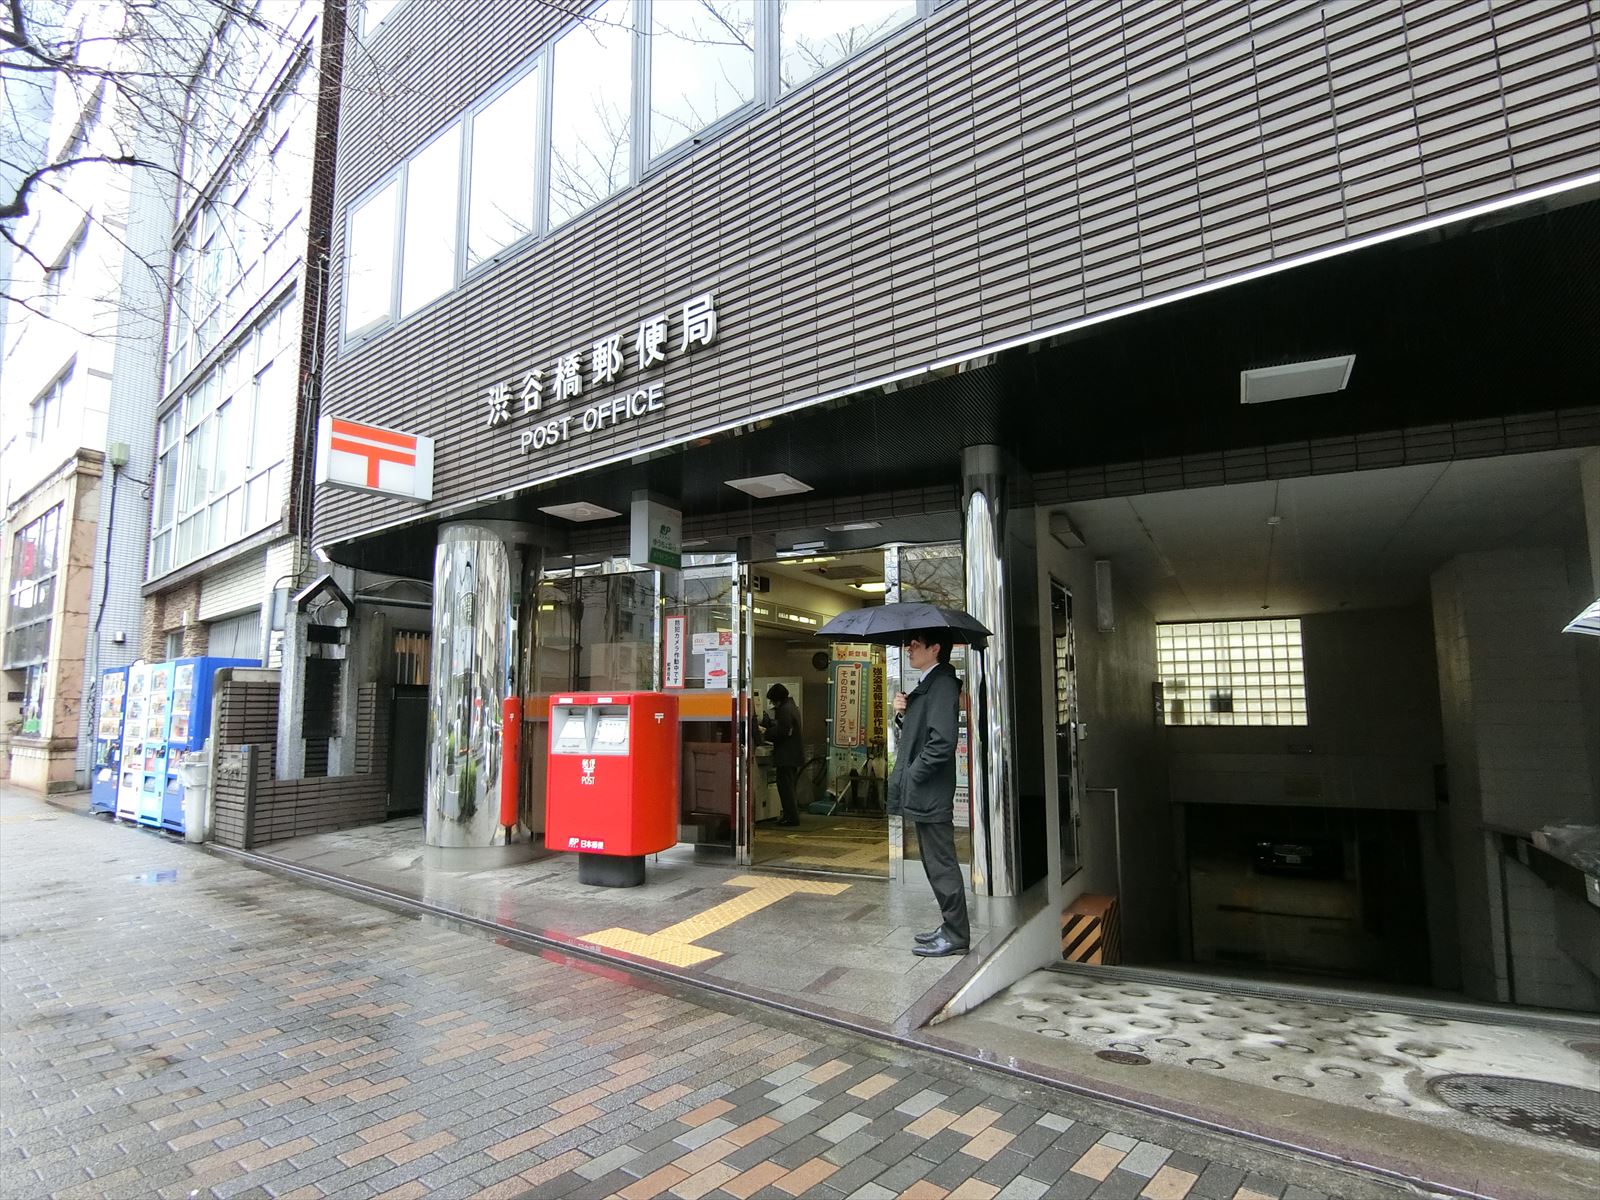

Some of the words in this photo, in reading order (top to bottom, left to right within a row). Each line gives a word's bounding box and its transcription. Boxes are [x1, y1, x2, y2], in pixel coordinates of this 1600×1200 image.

[487, 293, 718, 427] 渋谷橋郵便局
[521, 416, 574, 455] POST
[583, 382, 665, 433] OFFICE
[840, 670, 848, 733] その日からプラス
[581, 776, 595, 785] POST
